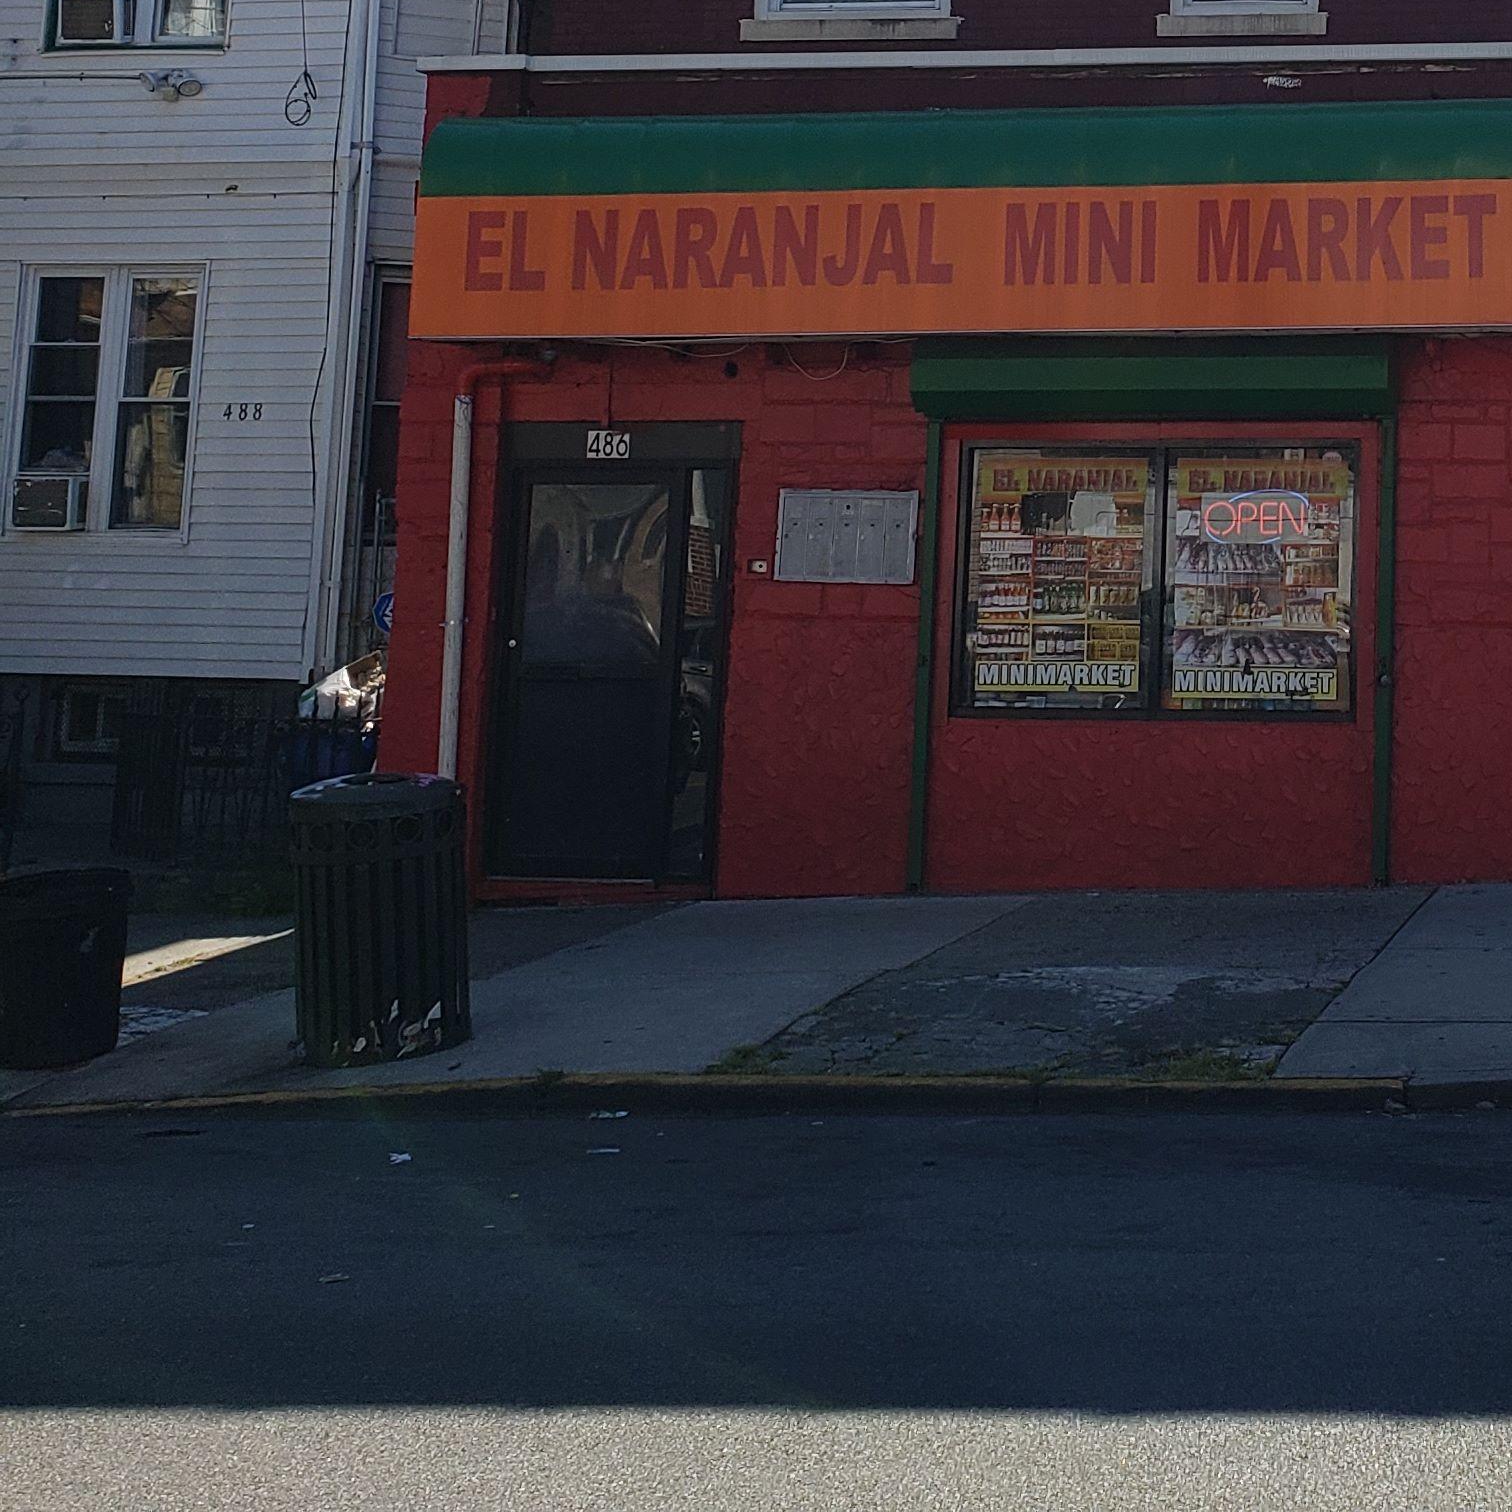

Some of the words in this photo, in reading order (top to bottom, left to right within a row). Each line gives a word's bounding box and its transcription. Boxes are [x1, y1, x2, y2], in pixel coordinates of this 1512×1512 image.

[464, 209, 546, 292] EL
[571, 201, 954, 290] NARANJAL
[1004, 199, 1157, 286] MINI
[1197, 193, 1498, 284] MARKET
[223, 402, 263, 421] 488
[588, 431, 628, 457] 486
[993, 468, 1020, 492] EL
[1188, 469, 1219, 493] EL
[1205, 501, 1305, 536] OPEN
[977, 662, 1136, 688] MINIMARKET
[1174, 669, 1334, 696] MINIMARKET
